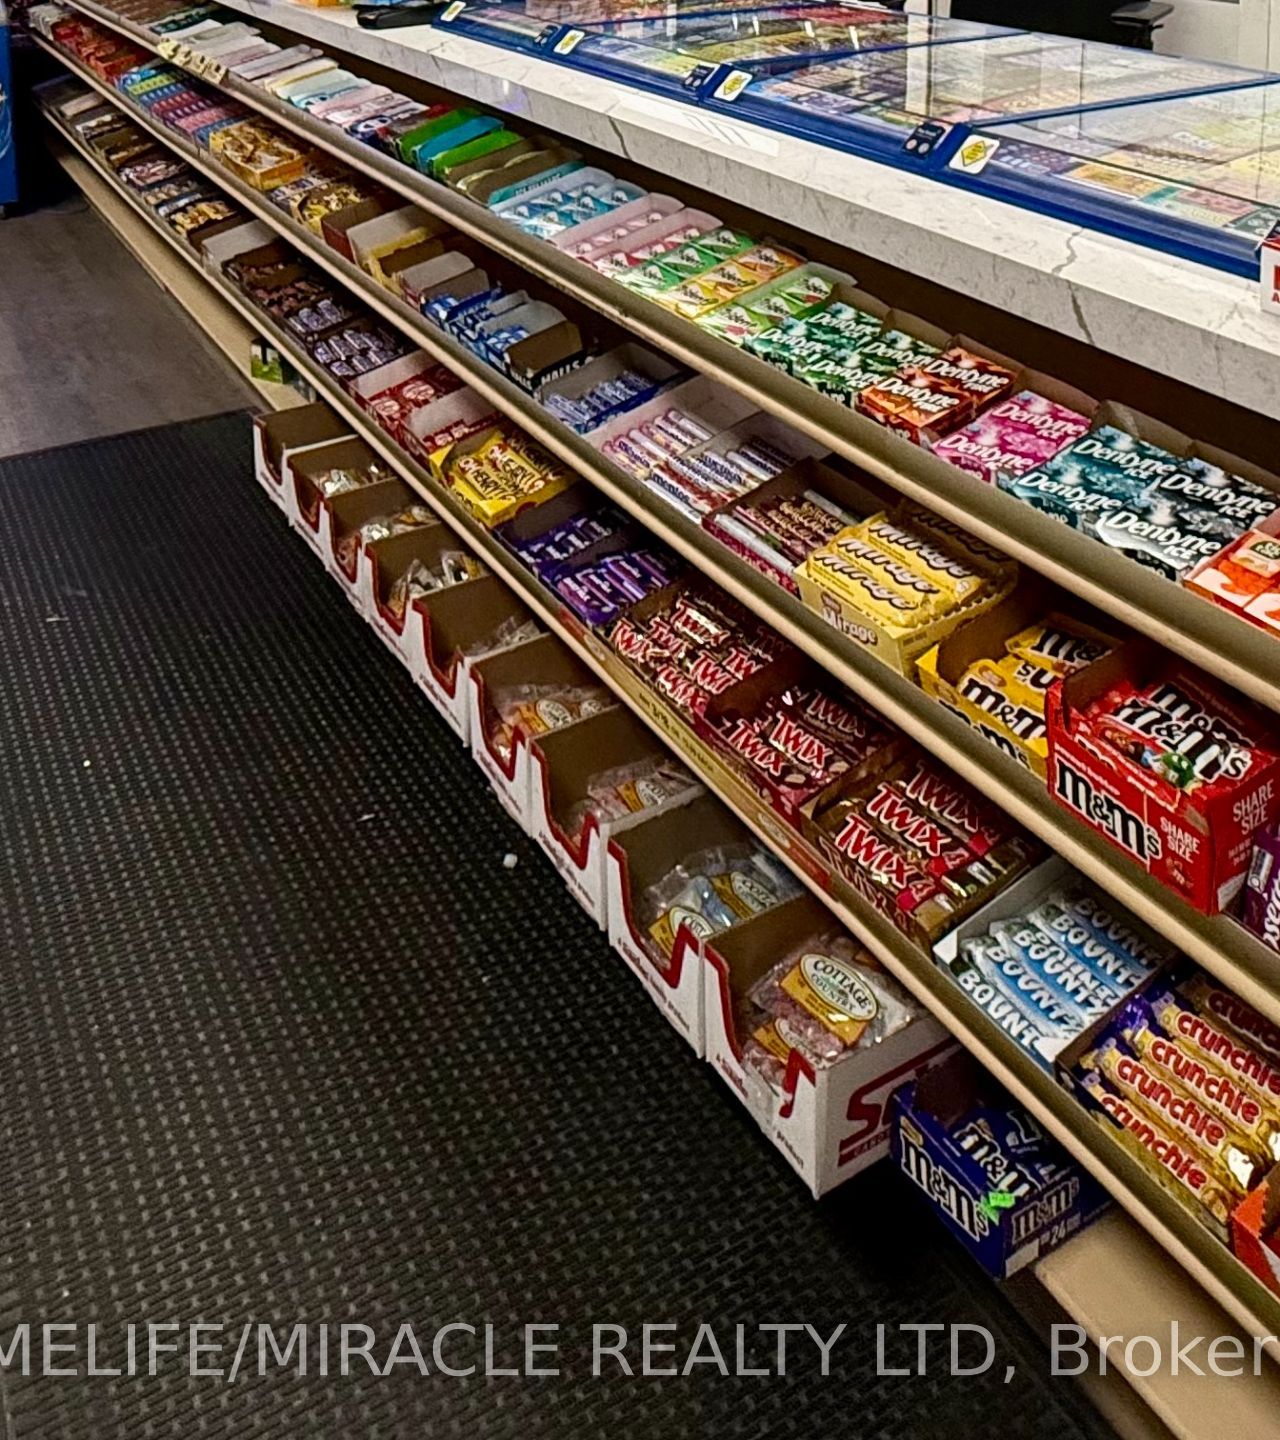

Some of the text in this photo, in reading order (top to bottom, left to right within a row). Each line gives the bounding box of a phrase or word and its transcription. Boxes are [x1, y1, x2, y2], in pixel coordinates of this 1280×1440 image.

[760, 328, 832, 353] Dentyne
[809, 312, 882, 337] Dentyne
[541, 359, 580, 386] HALLS
[927, 359, 1010, 387] Dentyne
[878, 378, 960, 409] Dentyne
[992, 403, 1086, 437] Dentyne
[943, 435, 1033, 470] Dentyne
[1073, 439, 1176, 477] Dentyne
[1020, 472, 1121, 509] Dentyne
[1164, 472, 1276, 518] Dentyne
[869, 521, 972, 578] Mirage
[1107, 510, 1222, 555] Dentyne
[838, 538, 940, 593] Mirage
[1256, 549, 1280, 561] tac
[813, 552, 919, 609] Mirage
[672, 600, 730, 646] TWIX
[822, 607, 878, 645] Mirage
[728, 719, 787, 775] TWIX
[771, 712, 833, 767] TWIX
[867, 782, 951, 856] TWIX
[1233, 779, 1275, 823] SHARE
[1160, 816, 1201, 853] SHARE
[1241, 807, 1268, 837] SIZE
[835, 813, 916, 888] TWIX
[1167, 833, 1194, 863] SIZE
[813, 960, 870, 1010] COTTAGE
